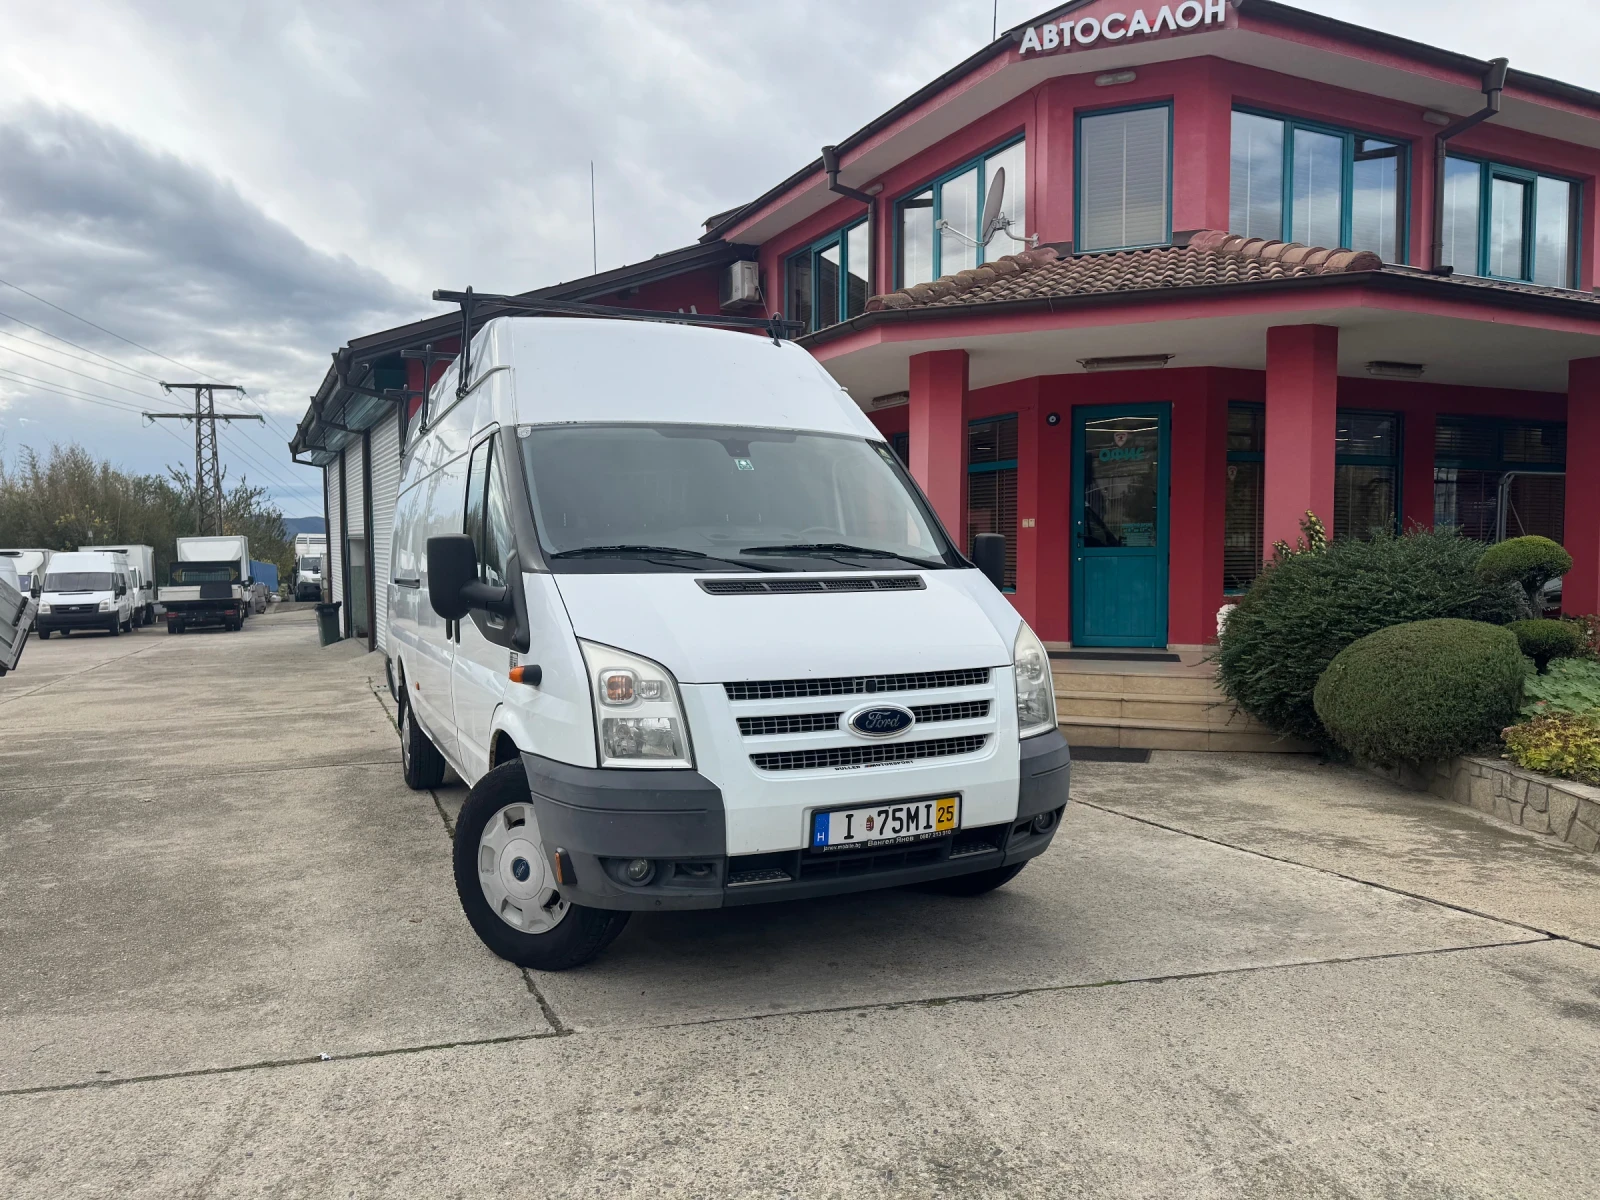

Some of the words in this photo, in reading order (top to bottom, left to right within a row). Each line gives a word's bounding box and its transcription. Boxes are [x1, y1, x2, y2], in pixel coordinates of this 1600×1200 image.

[1019, 0, 1226, 54] АВТОСАЛОН
[1099, 448, 1145, 462] ОФИС
[865, 711, 900, 729] Ford
[817, 832, 825, 842] H
[877, 804, 932, 835] 75MI
[937, 805, 954, 823] 25
